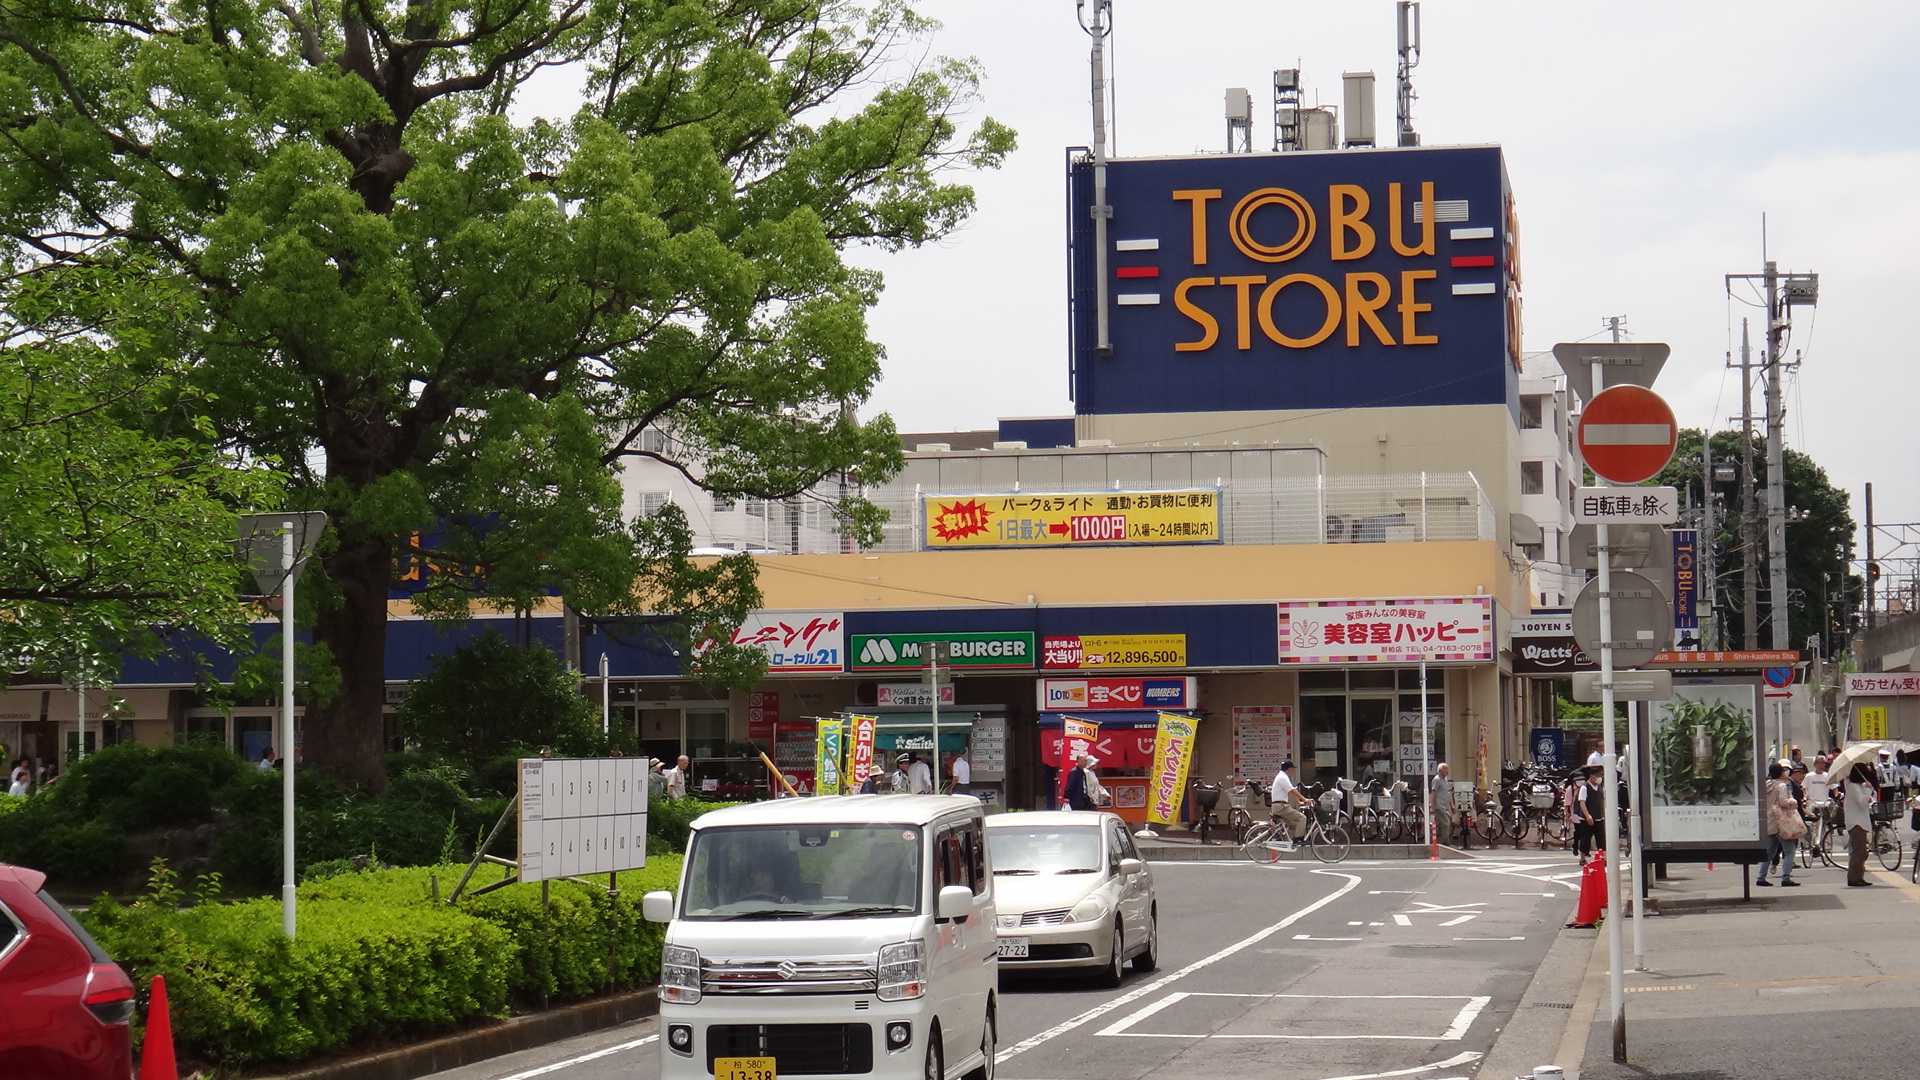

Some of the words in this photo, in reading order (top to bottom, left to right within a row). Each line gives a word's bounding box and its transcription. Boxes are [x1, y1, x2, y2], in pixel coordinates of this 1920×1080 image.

[1172, 181, 1436, 266] TOBU
[1174, 269, 1439, 352] STORE
[1583, 495, 1669, 517] 自転車を除く
[997, 519, 1049, 541] 1日最大
[1071, 517, 1126, 541] 1000円
[1677, 544, 1693, 590] TOBU
[1679, 591, 1687, 615] STORE
[1345, 608, 1426, 621] 家族みんなの美容室
[1323, 619, 1479, 645] 美容室ハッピー
[950, 641, 1026, 658] BURGER
[1422, 644, 1482, 652] 04-7163-0078
[1521, 644, 1572, 660] Watts
[1107, 651, 1177, 664] 12,896,500
[1678, 652, 1724, 661] 新柏駅
[1051, 689, 1070, 701] LOTO
[1090, 686, 1140, 702] 宝くじ
[855, 720, 873, 782] 合かぎ
[569, 782, 574, 795] 3
[588, 781, 592, 794] 5
[605, 780, 610, 793] 7
[550, 842, 555, 856] 2
[569, 841, 573, 853] 4
[998, 945, 1026, 956] 27-22
[747, 1060, 761, 1068] 580
